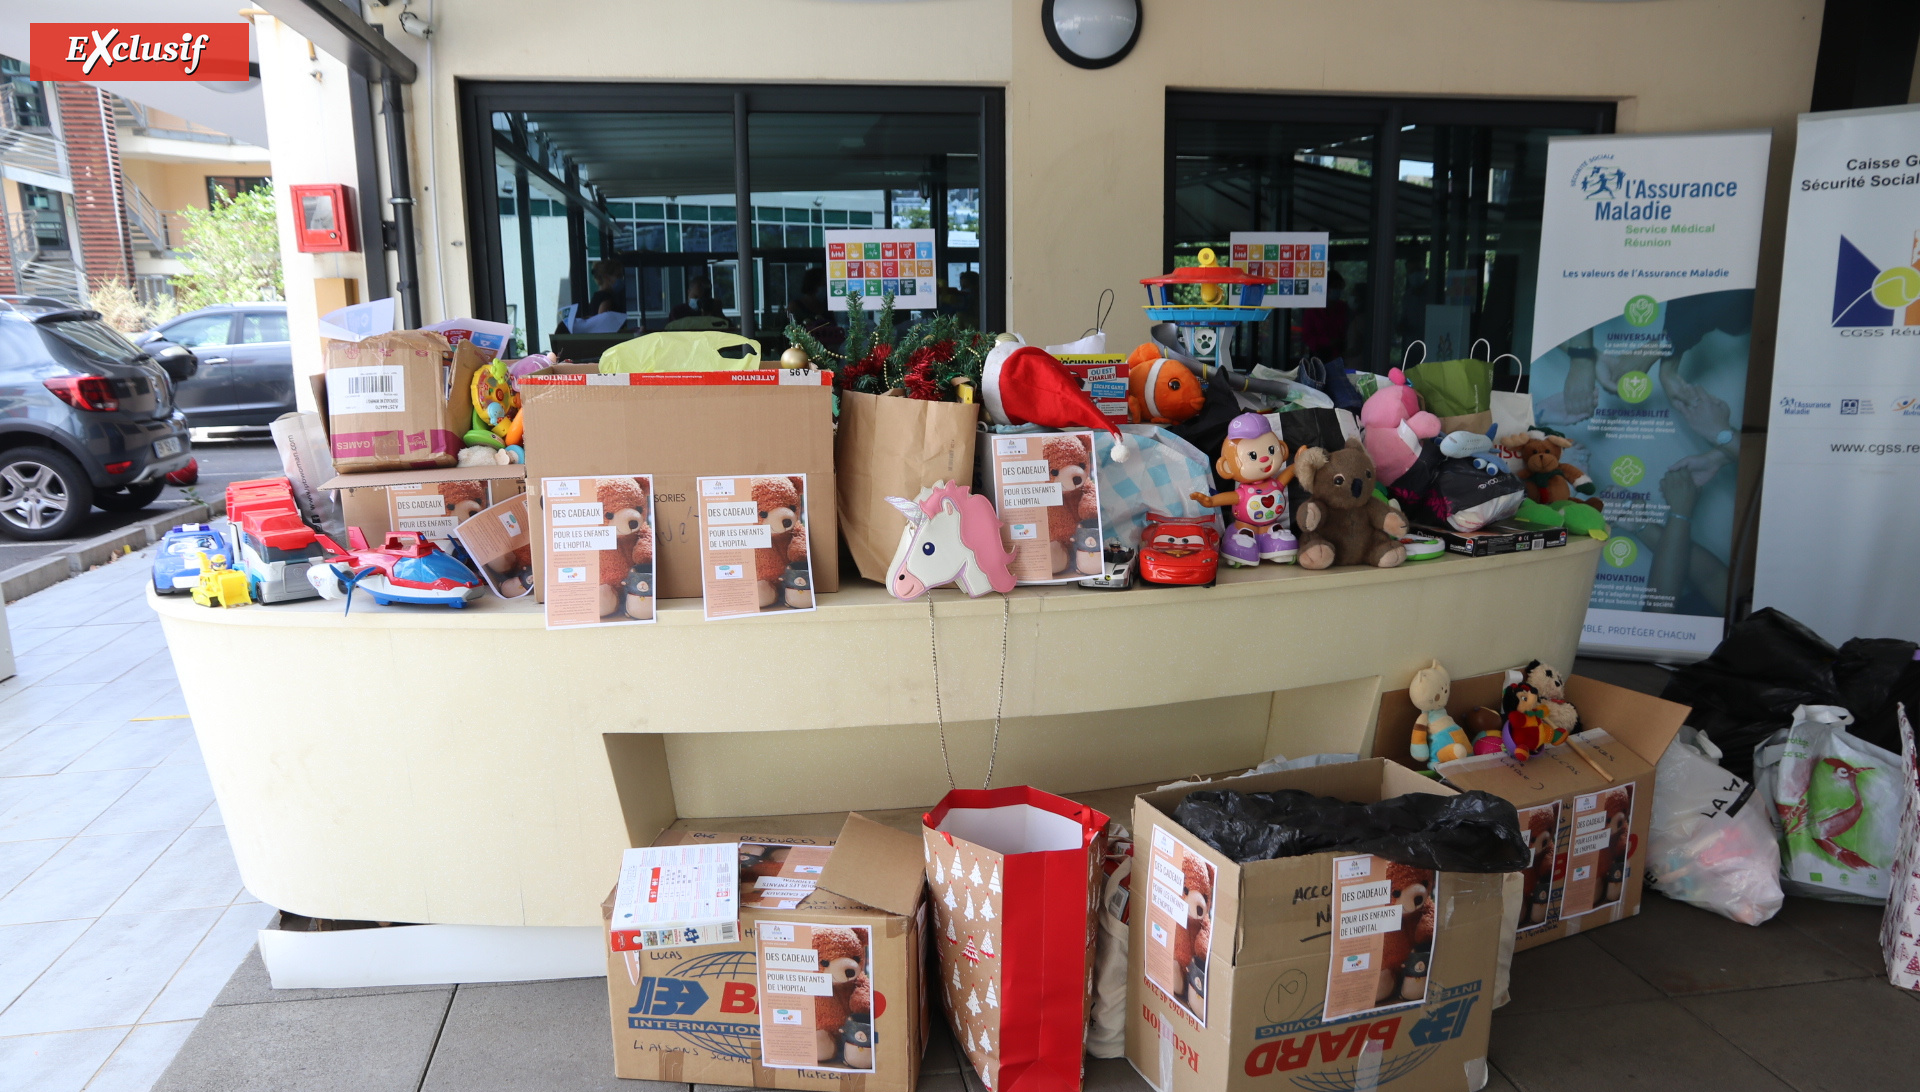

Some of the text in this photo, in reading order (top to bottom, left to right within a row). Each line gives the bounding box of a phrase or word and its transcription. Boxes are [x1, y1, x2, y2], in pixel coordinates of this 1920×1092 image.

[1846, 156, 1900, 171] Caisse
[1801, 176, 1866, 192] Sécurité
[1626, 180, 1737, 199] l'Assurance
[1595, 201, 1672, 221] Maladie
[1626, 224, 1715, 234] Service Médical
[1624, 238, 1671, 247] Réunion
[1563, 268, 1729, 278] Les valeurs de l'Assurance Maladie
[1840, 329, 1884, 338] CGSS
[1595, 408, 1669, 418] RESPONSABILITÉ
[336, 440, 371, 450] GAMES
[1003, 466, 1046, 476] DES CADEAUX
[1032, 486, 1056, 494] ENFANTS
[397, 500, 442, 509] DES CADEAUX
[553, 509, 600, 518] DES CADEAUX
[708, 507, 755, 517] DES CADEAUX
[1608, 626, 1696, 640] PROTÉGER CHACUN
[1342, 887, 1388, 902] DES CADEAUX
[1342, 909, 1396, 924] POUR LES ENFANTS
[1340, 924, 1377, 936] DE L'HOPITAL
[766, 953, 815, 963] DES CADEAUX
[798, 975, 824, 983] ENFANTS
[1244, 1016, 1402, 1078] BIARD
